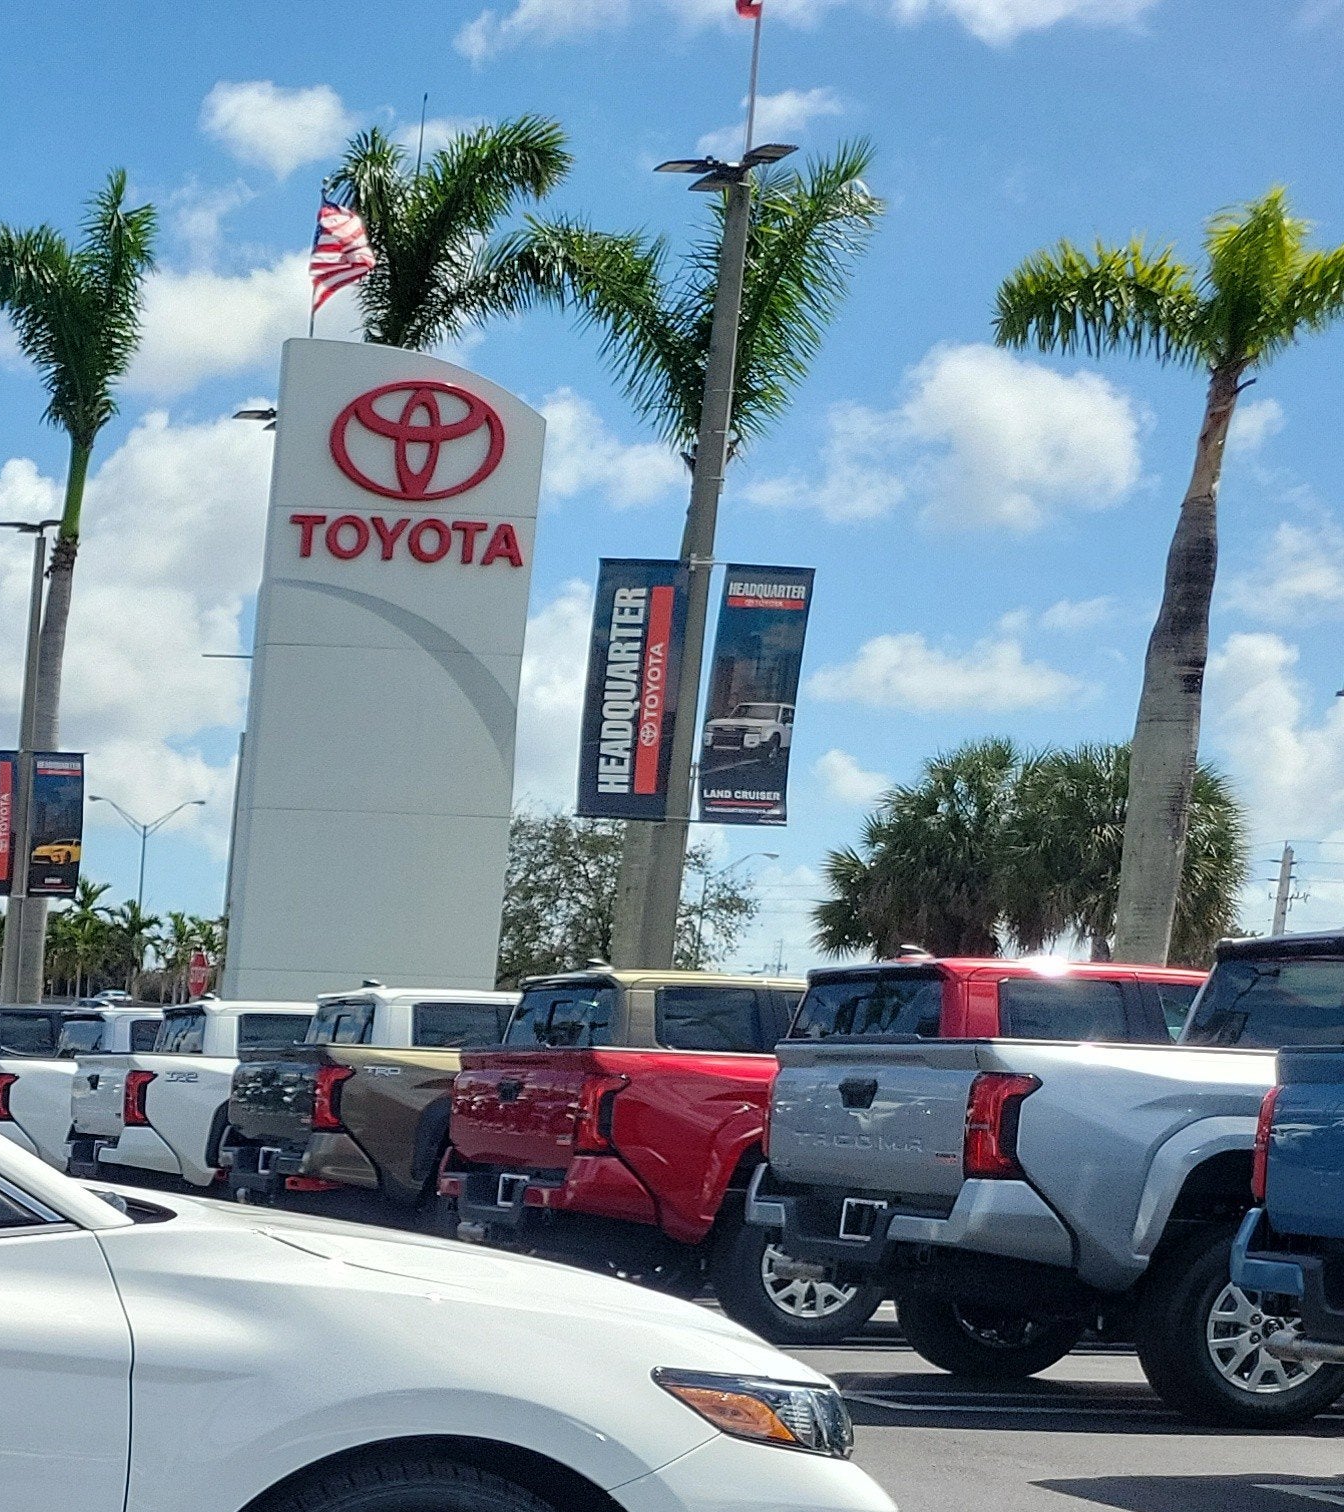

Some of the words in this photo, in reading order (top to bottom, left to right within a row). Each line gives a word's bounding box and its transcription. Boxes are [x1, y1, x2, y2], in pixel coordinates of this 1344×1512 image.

[289, 514, 523, 567] TOYOTA
[728, 582, 806, 599] HEADQUARTER
[597, 587, 647, 793] HEADQUARTER
[642, 642, 665, 718] TOYOTA
[703, 789, 732, 799] LAND
[734, 790, 781, 801] CRUISER
[0, 793, 10, 837] TOYOTA
[363, 1065, 401, 1077] TRD
[794, 1130, 923, 1152] TACOMA
